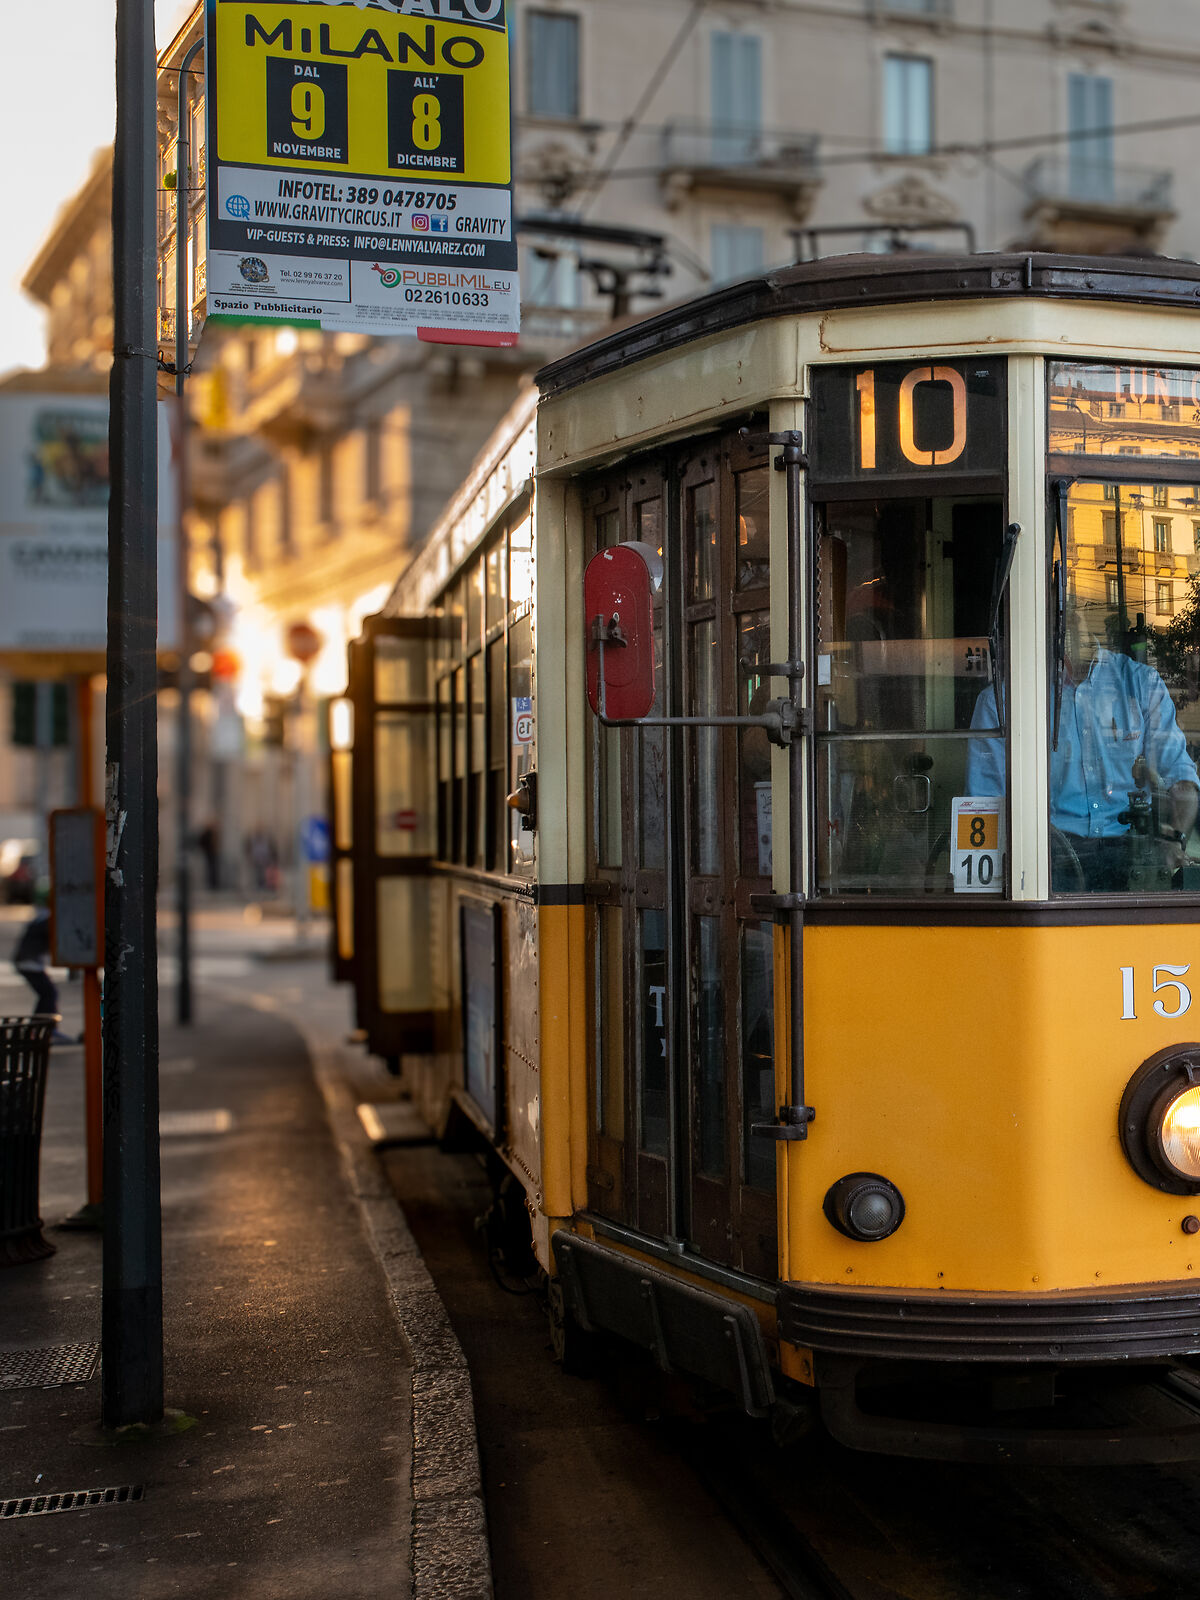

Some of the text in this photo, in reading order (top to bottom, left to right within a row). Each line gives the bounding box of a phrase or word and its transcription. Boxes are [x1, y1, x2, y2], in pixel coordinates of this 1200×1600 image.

[245, 14, 485, 69] MILANO
[293, 64, 320, 78] DAL
[413, 76, 440, 89] ALL'
[290, 81, 326, 140] 9
[411, 93, 442, 151] 8
[273, 142, 342, 159] NOVEMBRE
[397, 153, 457, 168] DICEMBRE
[278, 179, 457, 211] INFOTEL: 389 0478705
[254, 200, 402, 229] WWW.GRAVITYCIRCUS.IT
[455, 216, 506, 235] GRAVITY
[246, 228, 486, 257] VIP-GUESTS & PRESS: INFO@LENNYALVAREZ.COM
[280, 269, 291, 277] Tel.
[214, 299, 323, 315] Spazio Pubblicitario
[856, 366, 967, 469] 10
[970, 816, 986, 848] 8
[961, 854, 994, 886] 10
